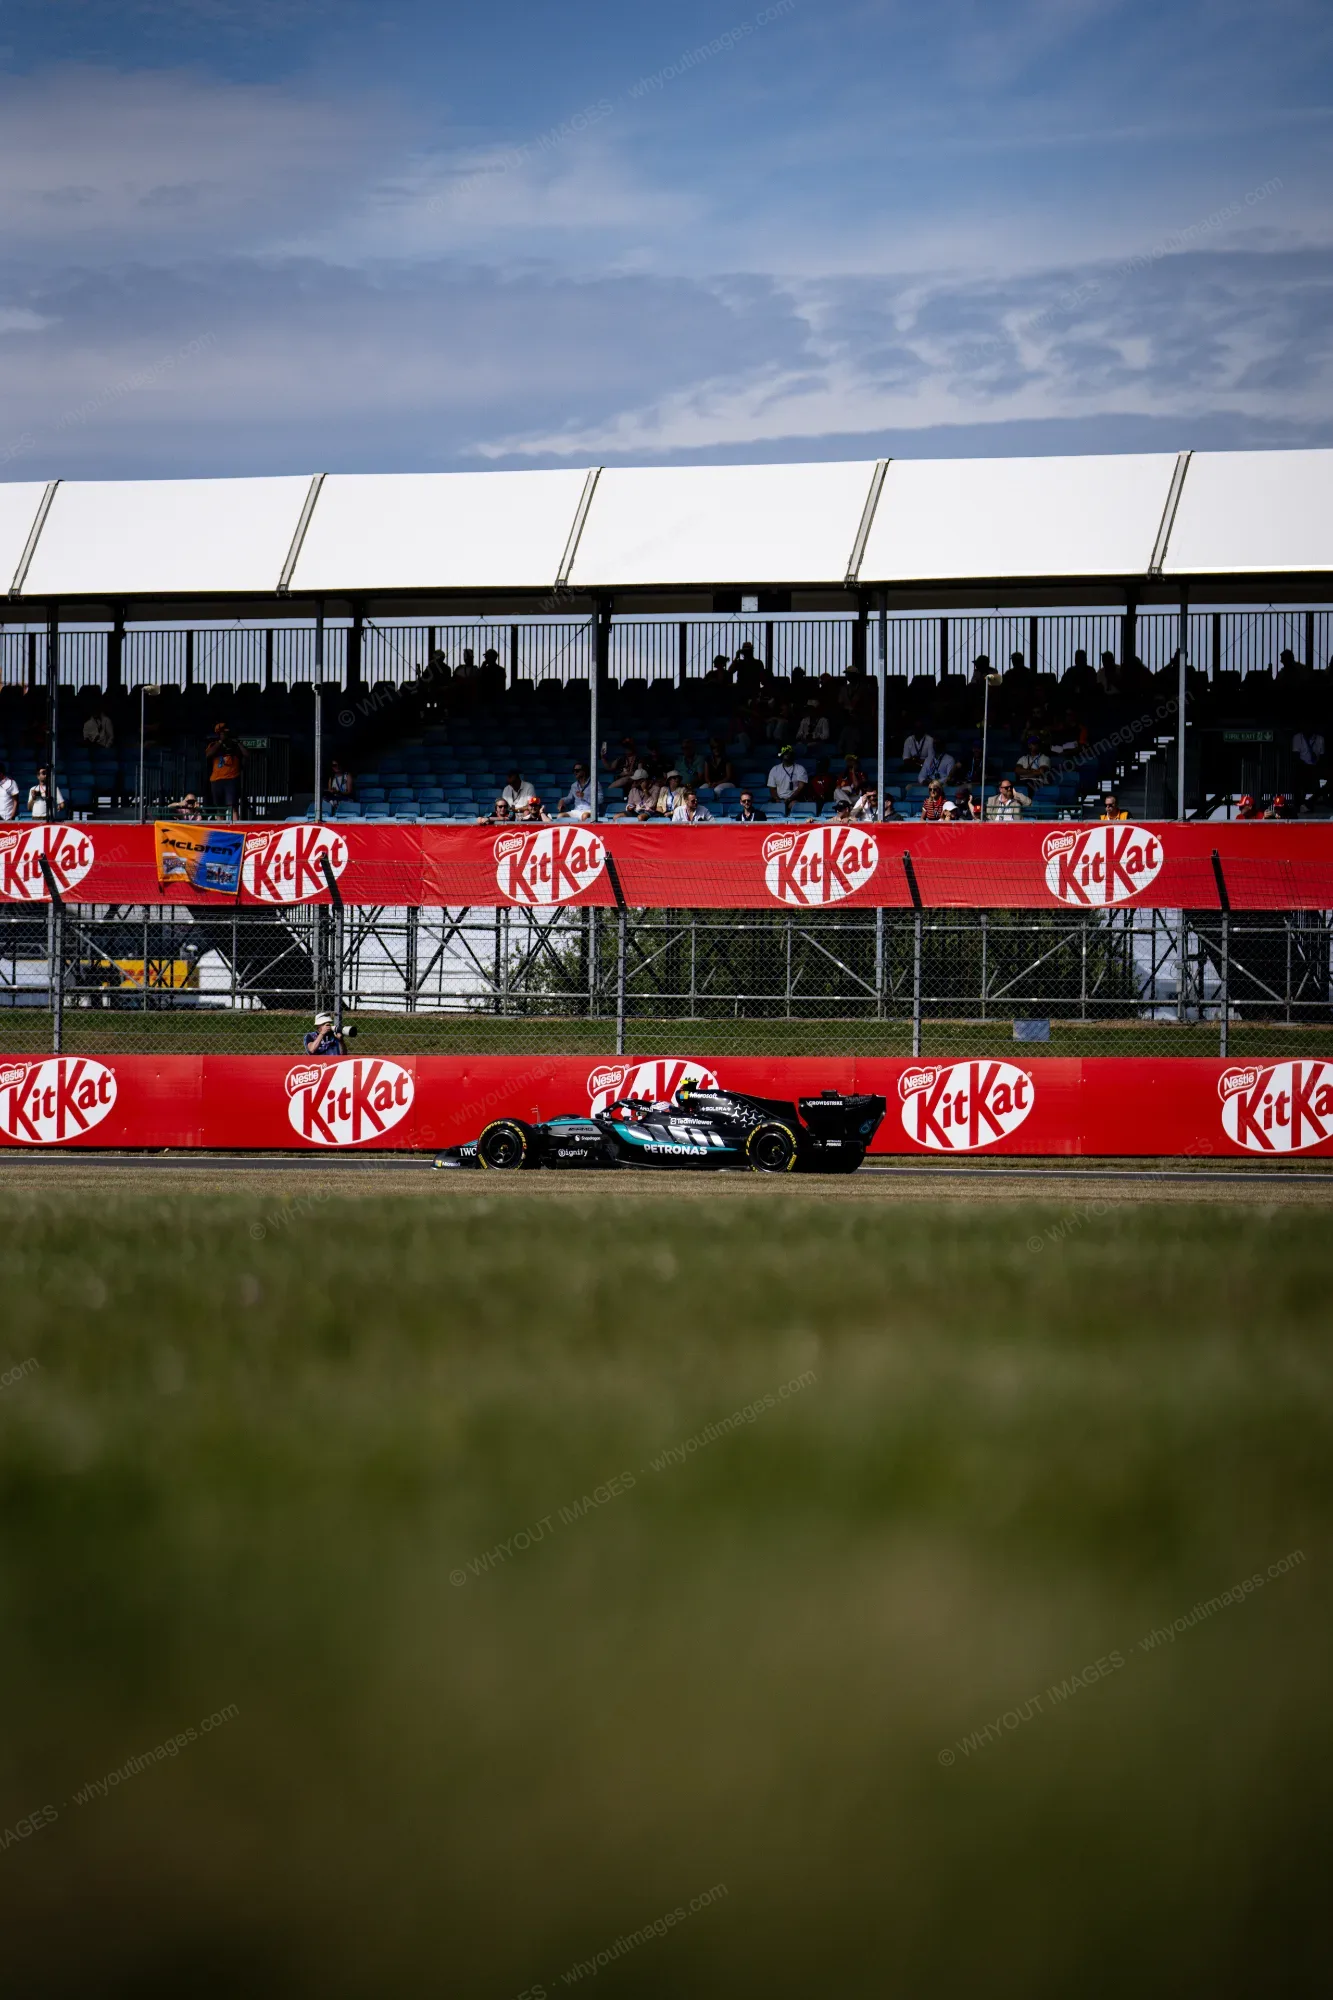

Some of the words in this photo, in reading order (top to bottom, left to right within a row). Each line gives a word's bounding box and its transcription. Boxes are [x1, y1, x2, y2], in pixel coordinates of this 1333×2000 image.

[4, 827, 90, 899] KitKat
[161, 838, 233, 856] McLaren
[253, 827, 343, 901] KitKat
[508, 828, 601, 903] KitKat
[777, 828, 874, 904] KitKat
[1058, 827, 1158, 904] KitKat
[8, 1059, 112, 1141] KitKat
[302, 1060, 409, 1143] KitKat
[916, 1062, 1029, 1148] KitKat
[460, 1146, 477, 1157] IWC
[643, 1143, 708, 1156] PETRONAS
